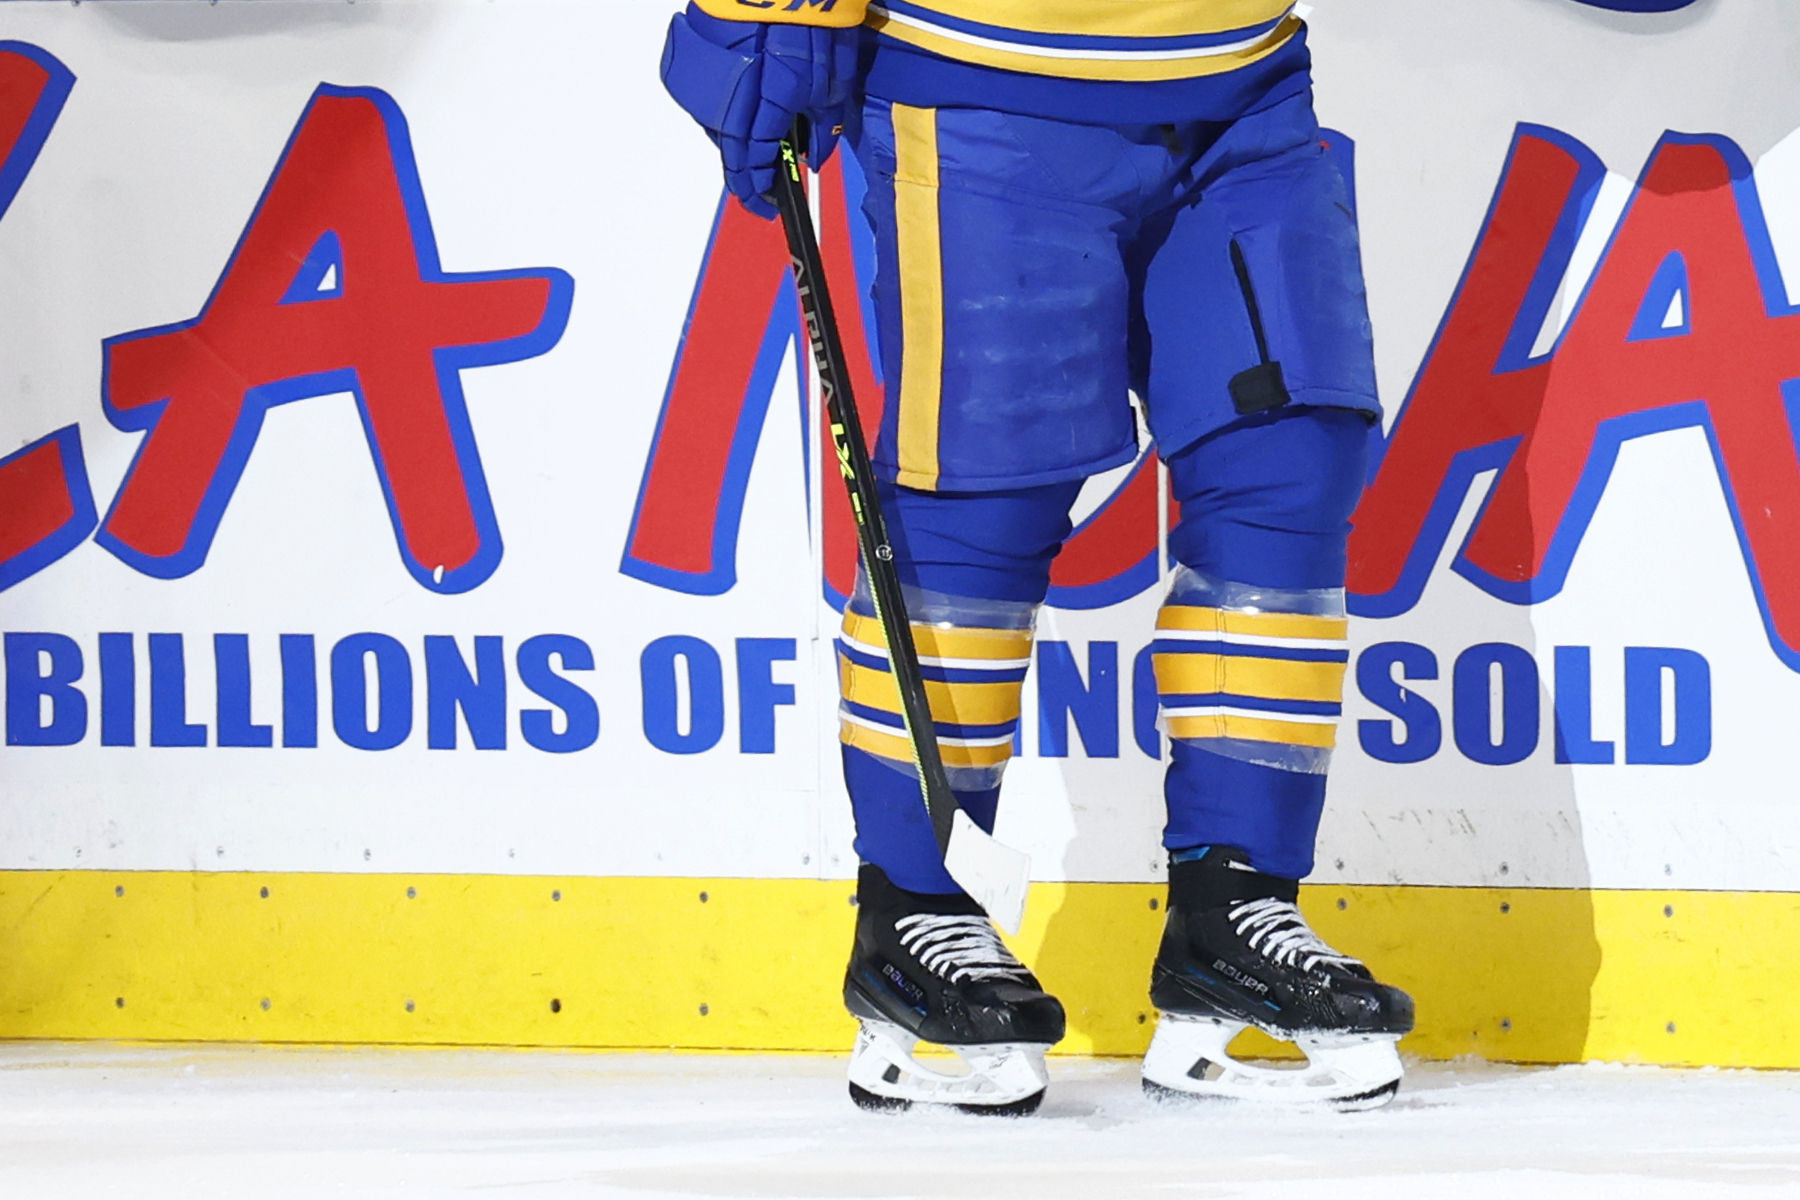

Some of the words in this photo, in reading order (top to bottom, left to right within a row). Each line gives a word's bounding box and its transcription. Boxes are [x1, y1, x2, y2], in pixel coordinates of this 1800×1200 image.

[3, 631, 601, 752] BILLIONS
[640, 633, 797, 755] OF
[1354, 643, 1713, 766] SOLD
